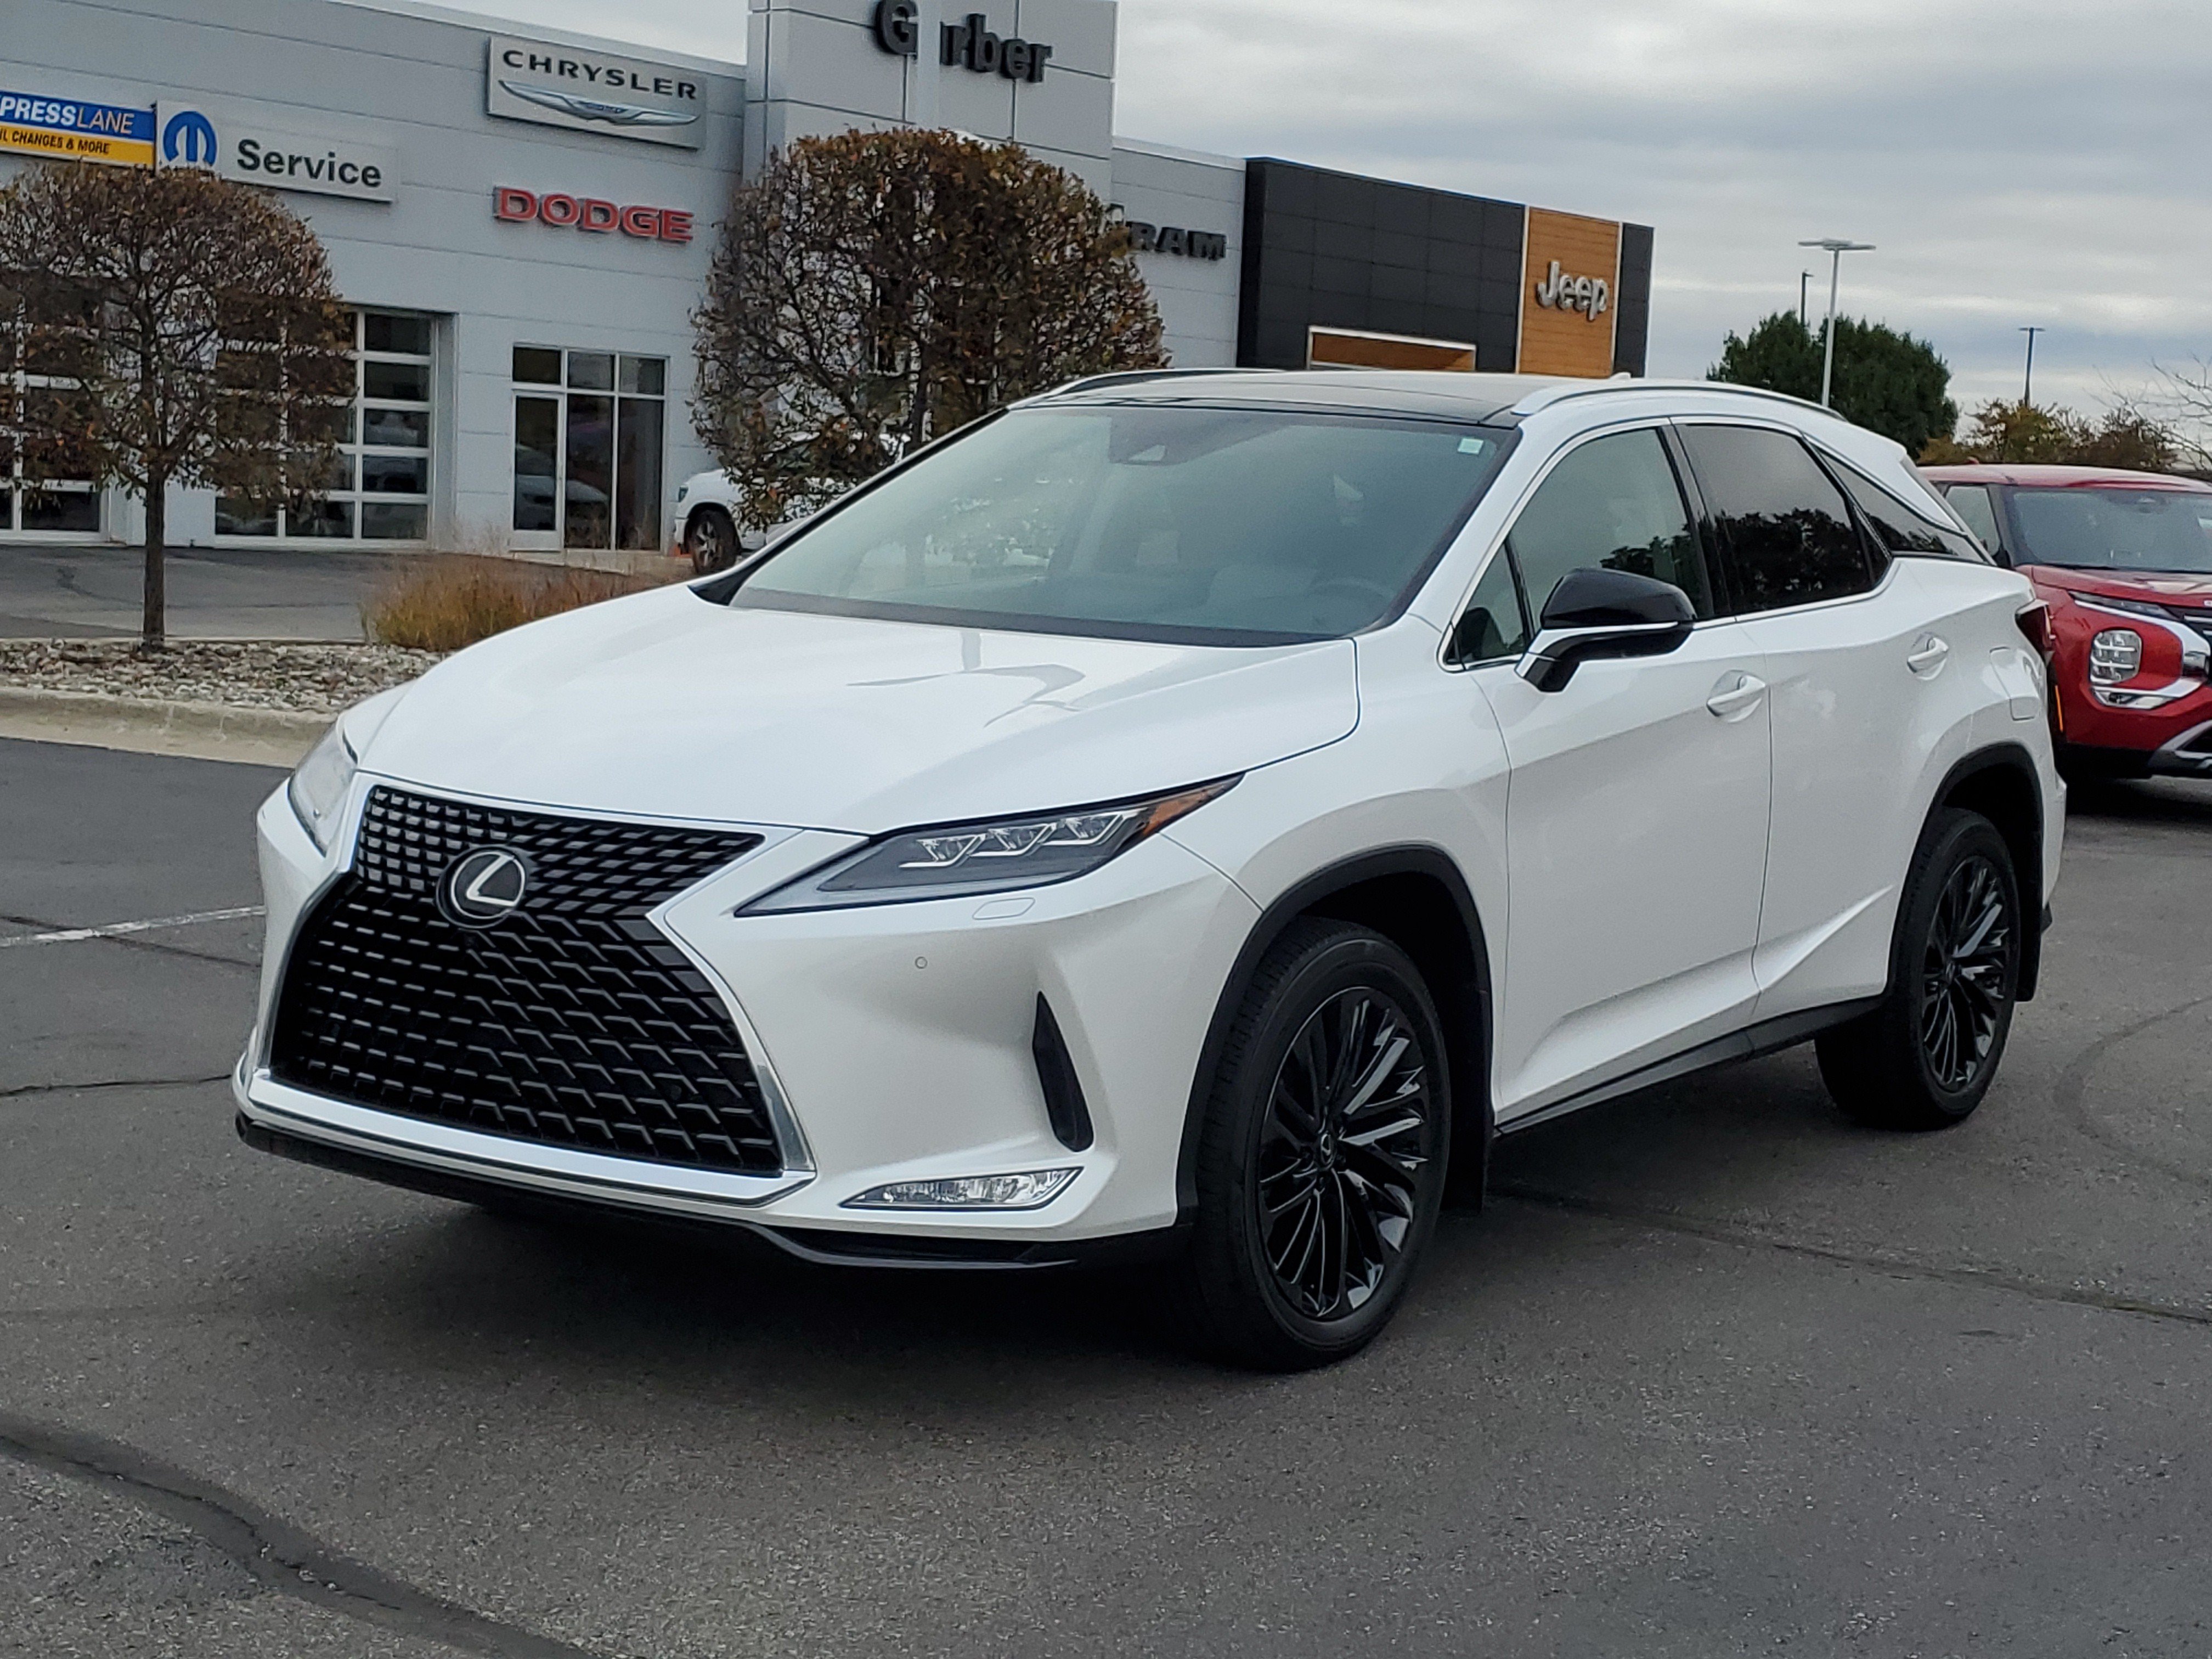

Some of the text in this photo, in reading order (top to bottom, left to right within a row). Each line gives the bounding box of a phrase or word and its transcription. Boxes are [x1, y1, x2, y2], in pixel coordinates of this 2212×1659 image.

[876, 0, 1053, 82] Grber
[503, 50, 697, 99] CHRYSLER
[0, 95, 134, 134] PRESSLANE
[12, 130, 63, 148] CHANGES
[77, 139, 110, 154] MORE
[237, 139, 382, 187] Service
[495, 186, 694, 242] DODGE
[1125, 221, 1227, 261] RAM
[1536, 260, 1609, 322] Jeep
